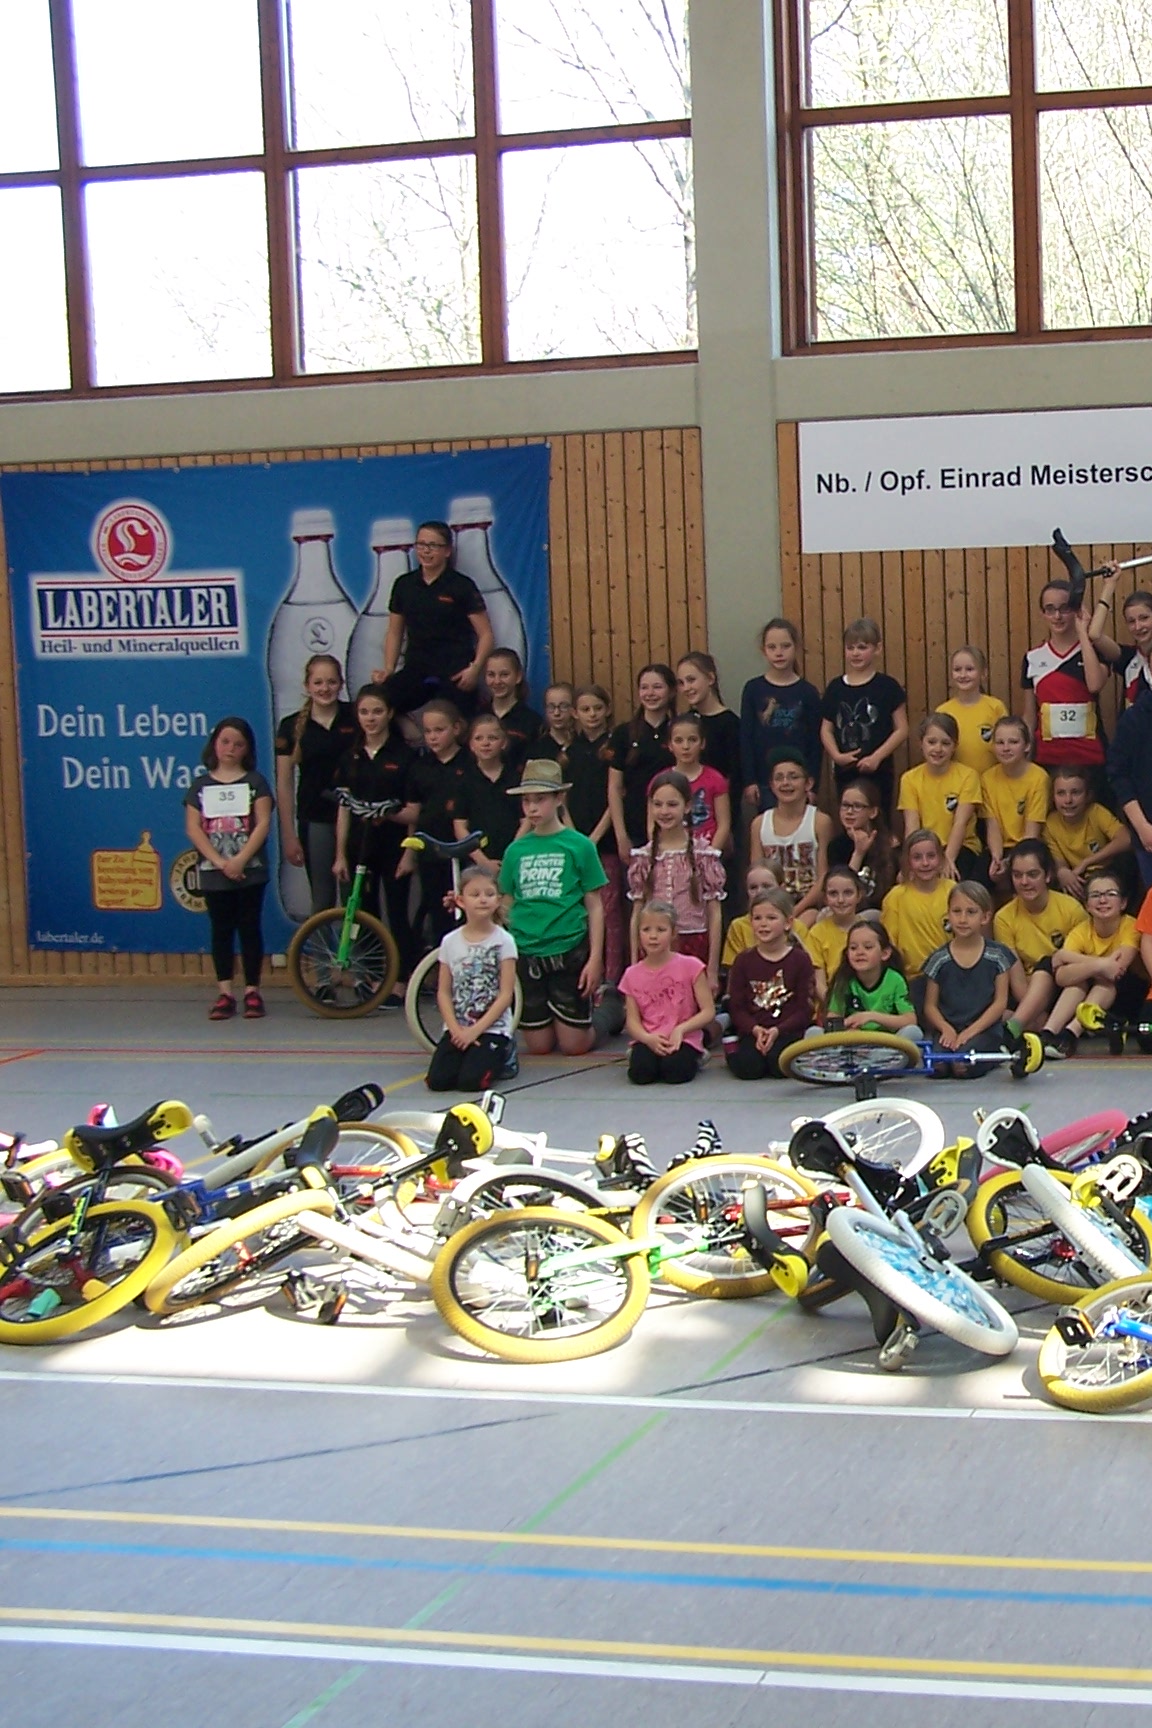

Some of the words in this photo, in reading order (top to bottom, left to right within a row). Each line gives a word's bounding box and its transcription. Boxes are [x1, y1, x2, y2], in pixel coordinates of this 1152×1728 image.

[816, 473, 857, 494] Nb.
[880, 469, 932, 496] Opf.
[940, 465, 1021, 489] Einrad
[44, 587, 231, 629] LABERTALER
[41, 639, 78, 654] Heil-
[82, 639, 113, 653] und
[118, 637, 240, 656] Mineralquellen
[37, 704, 106, 738] Dein
[1060, 709, 1076, 722] 32
[62, 756, 131, 790] Dein
[219, 790, 236, 802] 35
